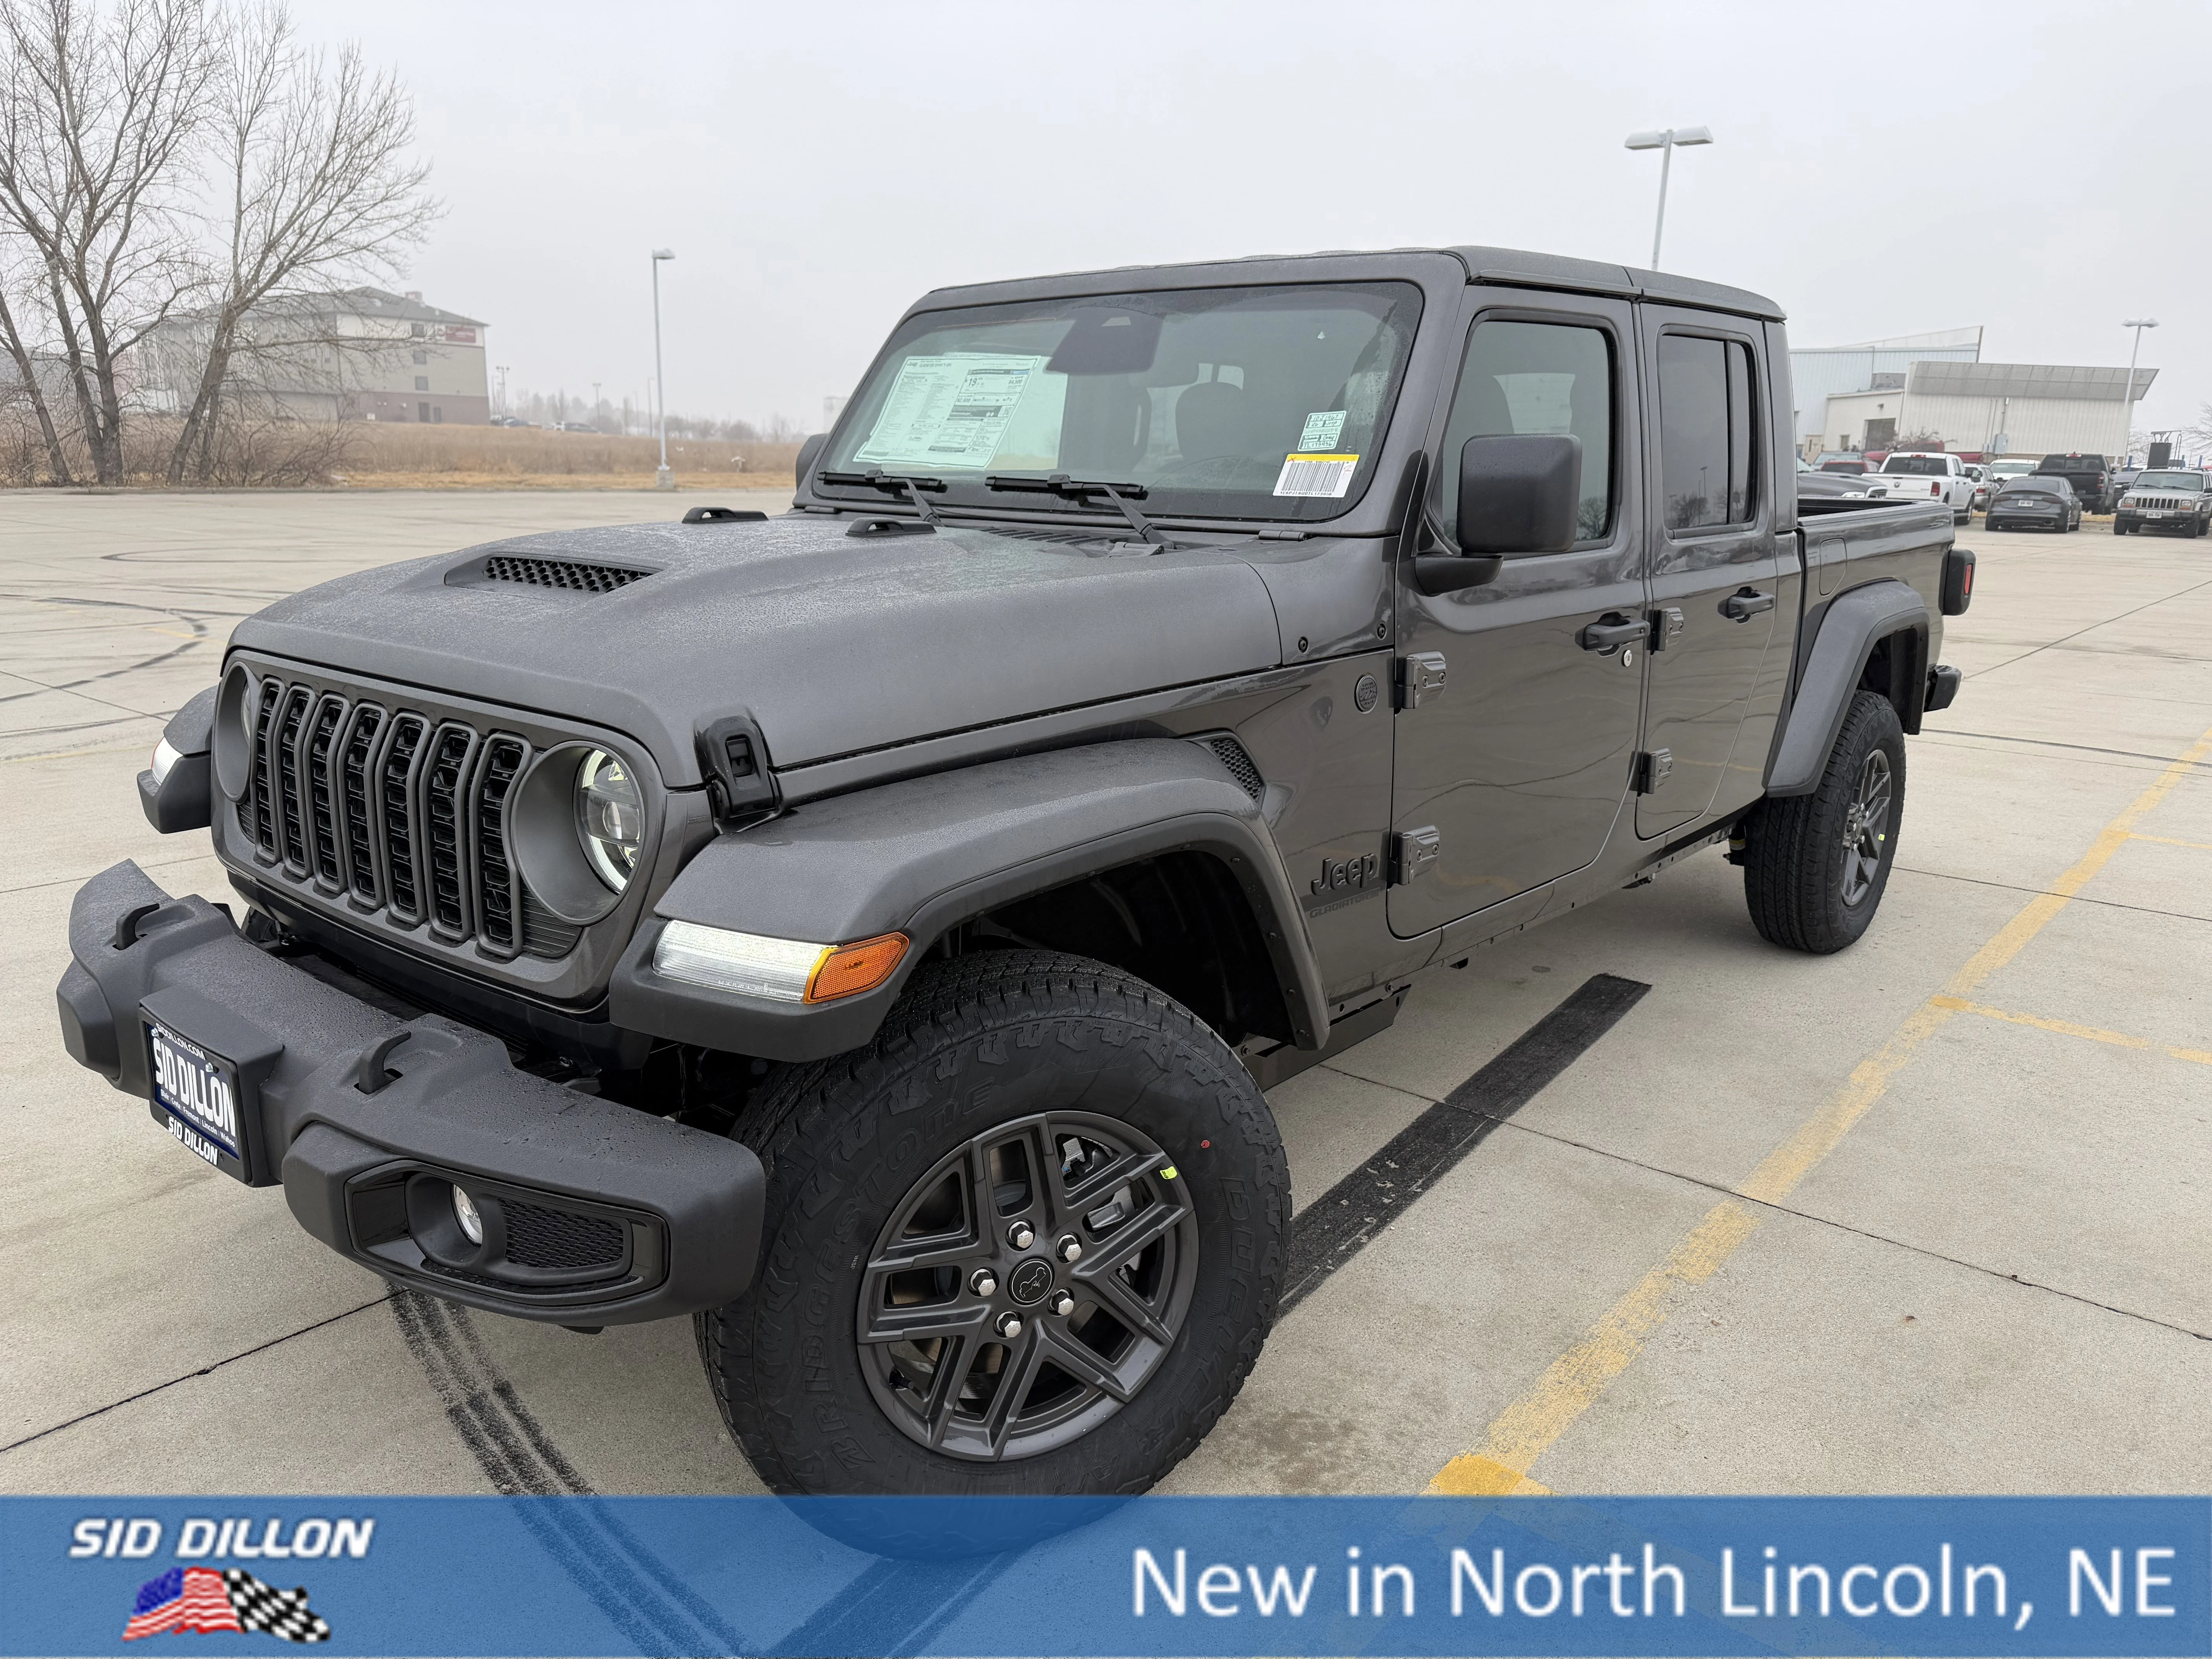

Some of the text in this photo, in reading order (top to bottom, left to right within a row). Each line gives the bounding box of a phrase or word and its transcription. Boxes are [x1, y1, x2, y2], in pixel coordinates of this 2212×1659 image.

[968, 378, 977, 386] 19
[1311, 853, 1378, 896] Jeep
[1310, 890, 1370, 919] GLADIATOR
[153, 1037, 236, 1137] SID DILLON
[168, 1116, 218, 1166] SID DILLON
[183, 1106, 200, 1124] Fremont
[202, 1119, 218, 1136] Lincoln
[220, 1131, 235, 1147] Wahoo
[802, 1077, 995, 1472] BRIDGESTONE
[1135, 1176, 1256, 1457] DUELER
